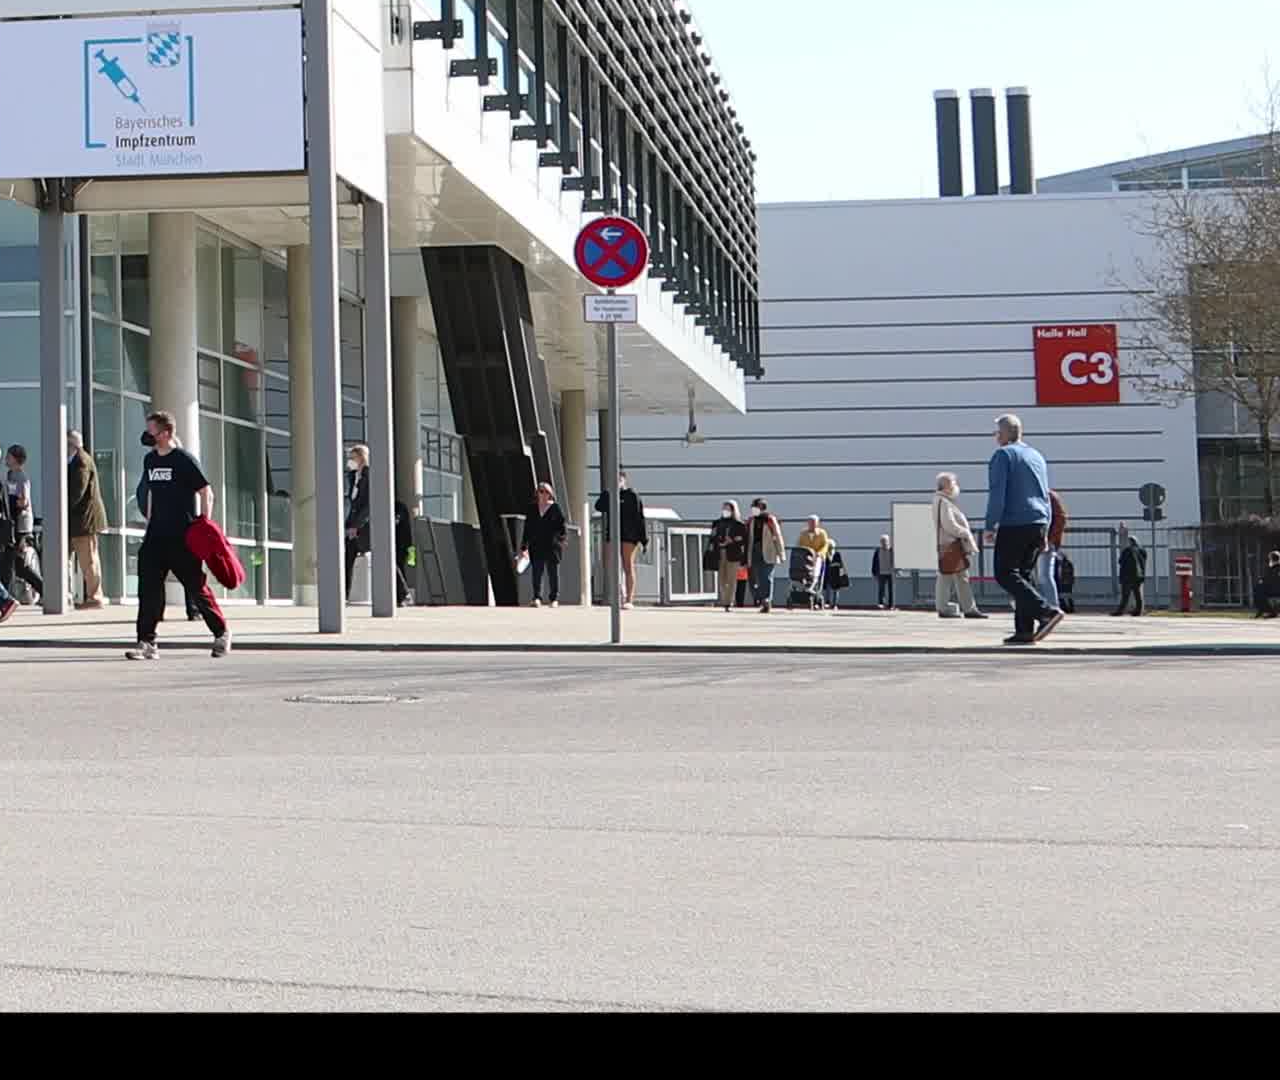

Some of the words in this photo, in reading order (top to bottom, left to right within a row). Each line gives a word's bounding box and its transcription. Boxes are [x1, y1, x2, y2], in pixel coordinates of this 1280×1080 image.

[115, 133, 196, 150] Impfzentrum
[1037, 328, 1063, 338] Halle
[1067, 328, 1088, 337] Hall
[1060, 351, 1114, 385] C3
[148, 467, 173, 481] VANS
